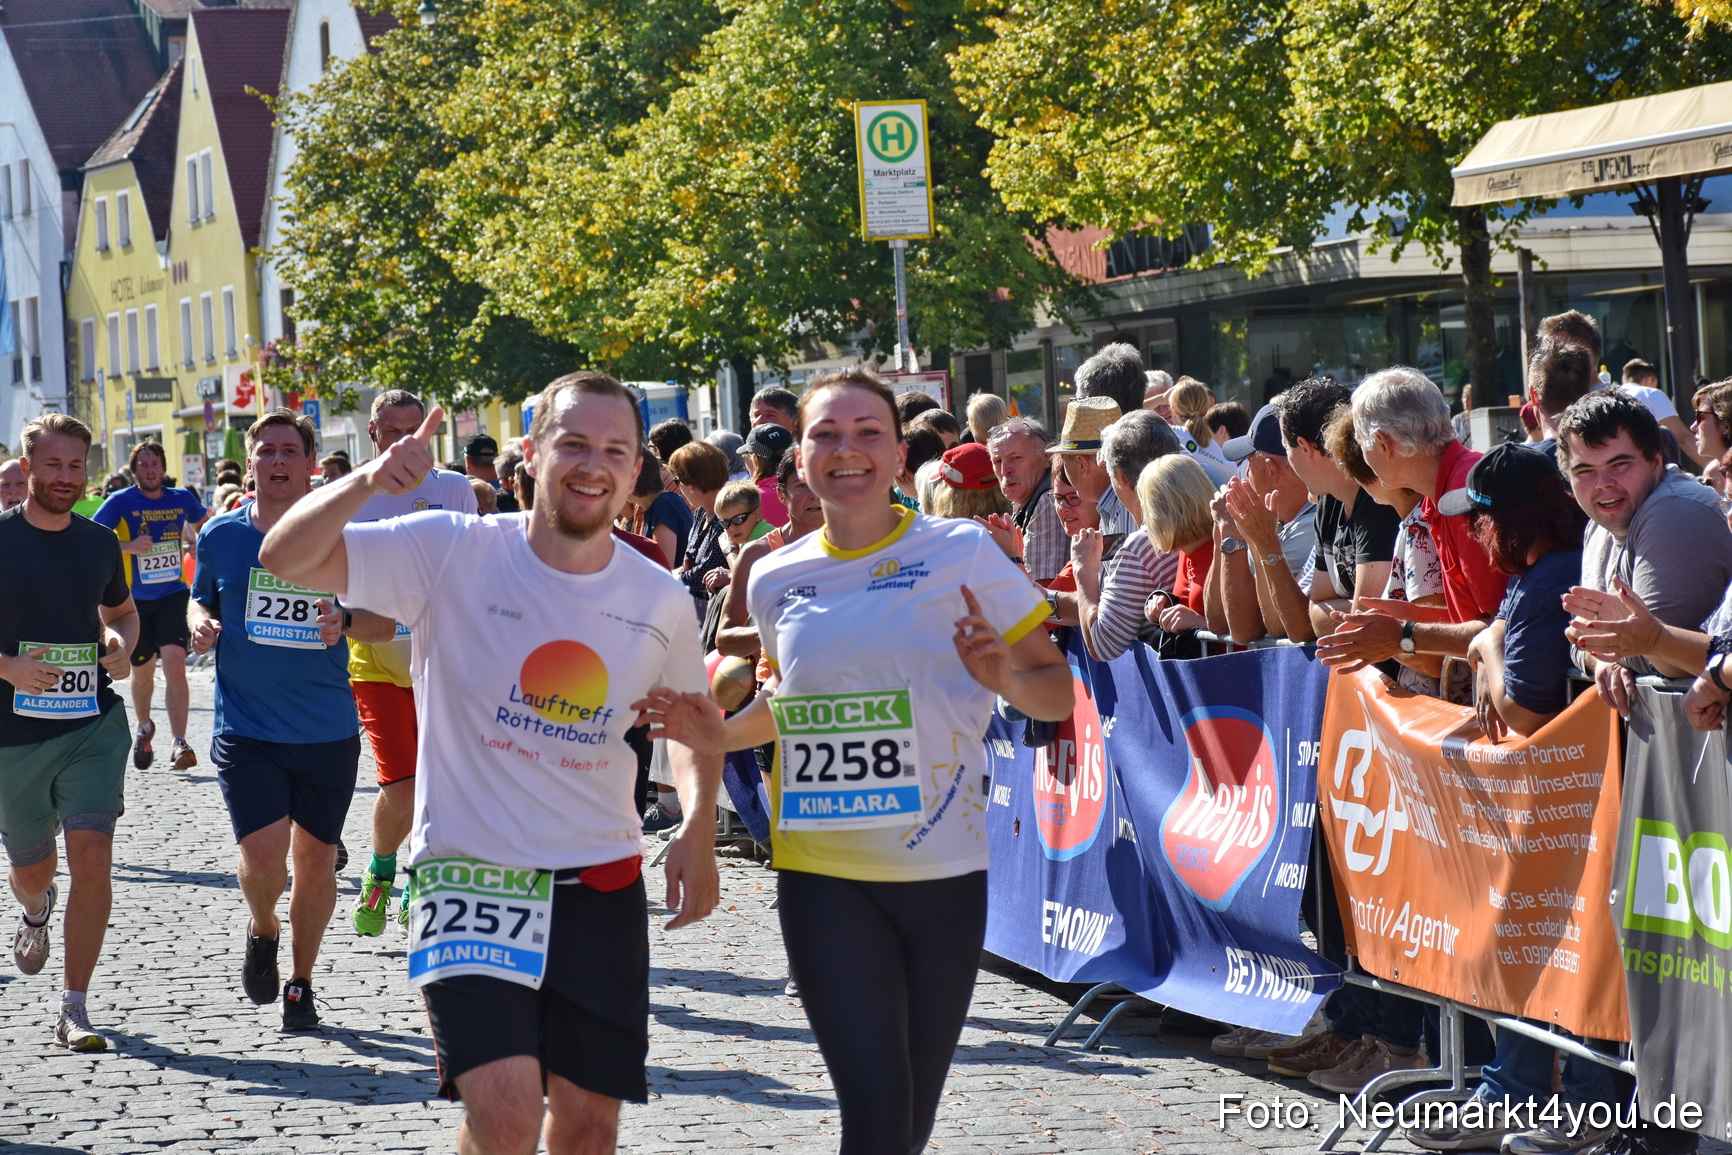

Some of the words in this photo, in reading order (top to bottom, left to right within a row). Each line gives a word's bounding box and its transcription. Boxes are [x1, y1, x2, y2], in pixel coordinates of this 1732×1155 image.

[873, 169, 916, 179] Marktplatz
[111, 277, 134, 303] HOTEL
[138, 393, 171, 401] TAIFUN
[142, 508, 183, 516] NEUMARKTER
[414, 501, 428, 510] 20
[141, 514, 178, 522] STADTLAUF
[143, 554, 177, 571] 2220
[147, 570, 176, 579] MANUEL
[873, 559, 899, 578] 20
[499, 608, 523, 621] JAKO
[22, 697, 89, 709] ALEXANDER
[508, 683, 614, 727] Lauftreff
[781, 694, 901, 731] BOCK
[495, 705, 608, 745] Röttenbach
[480, 733, 513, 752] Lauf
[517, 746, 541, 763] mit
[560, 756, 593, 772] bleib
[596, 758, 610, 772] fit
[794, 738, 902, 783] 2258
[992, 739, 1015, 760] ONLINE
[1529, 744, 1586, 765] Partner
[1511, 774, 1529, 795] und
[1529, 770, 1604, 796] Umsetzung
[798, 792, 901, 815] KIM-LARA
[928, 784, 957, 827] September
[954, 764, 966, 785] 2019
[1476, 800, 1512, 825] Projekte
[1512, 808, 1535, 825] was
[1535, 800, 1594, 824] Internet
[1514, 832, 1580, 856] Werbung
[418, 861, 538, 897] BOCK
[1510, 891, 1537, 910] Sie
[1537, 886, 1564, 908] sich
[420, 897, 532, 941] 2257
[1494, 918, 1527, 938] web:
[427, 944, 517, 969] MANUEL
[1497, 945, 1522, 966] tel:
[1521, 944, 1553, 968] 09181
[1620, 937, 1710, 986] inspired
[1712, 955, 1726, 999] by
[1224, 945, 1256, 996] GET
